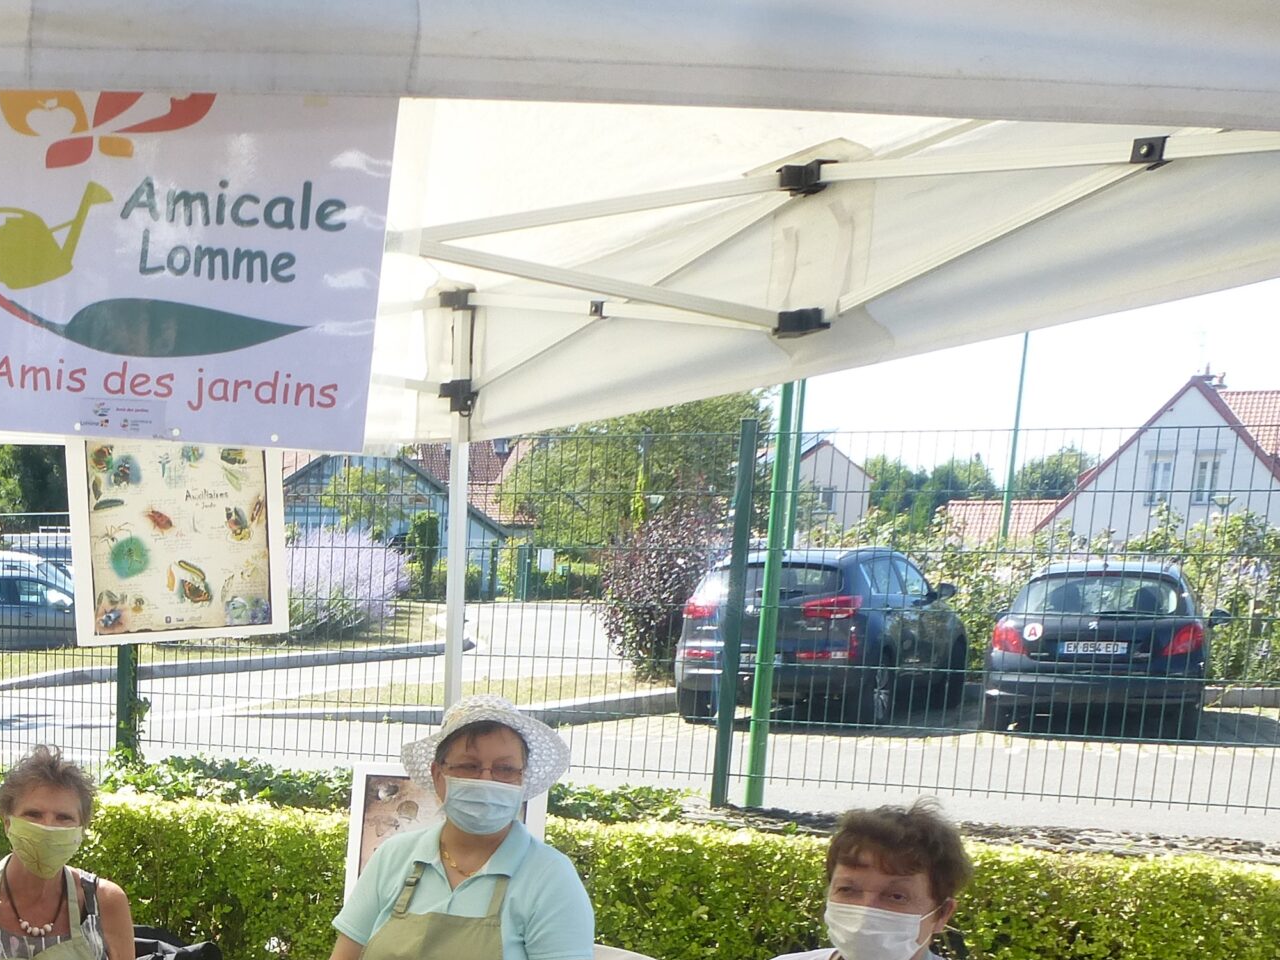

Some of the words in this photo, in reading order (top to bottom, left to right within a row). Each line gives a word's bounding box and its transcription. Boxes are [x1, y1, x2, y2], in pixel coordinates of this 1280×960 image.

[120, 176, 347, 232] Amicale
[138, 229, 297, 283] Lomme
[103, 361, 175, 398] des
[188, 367, 339, 411] jardins
